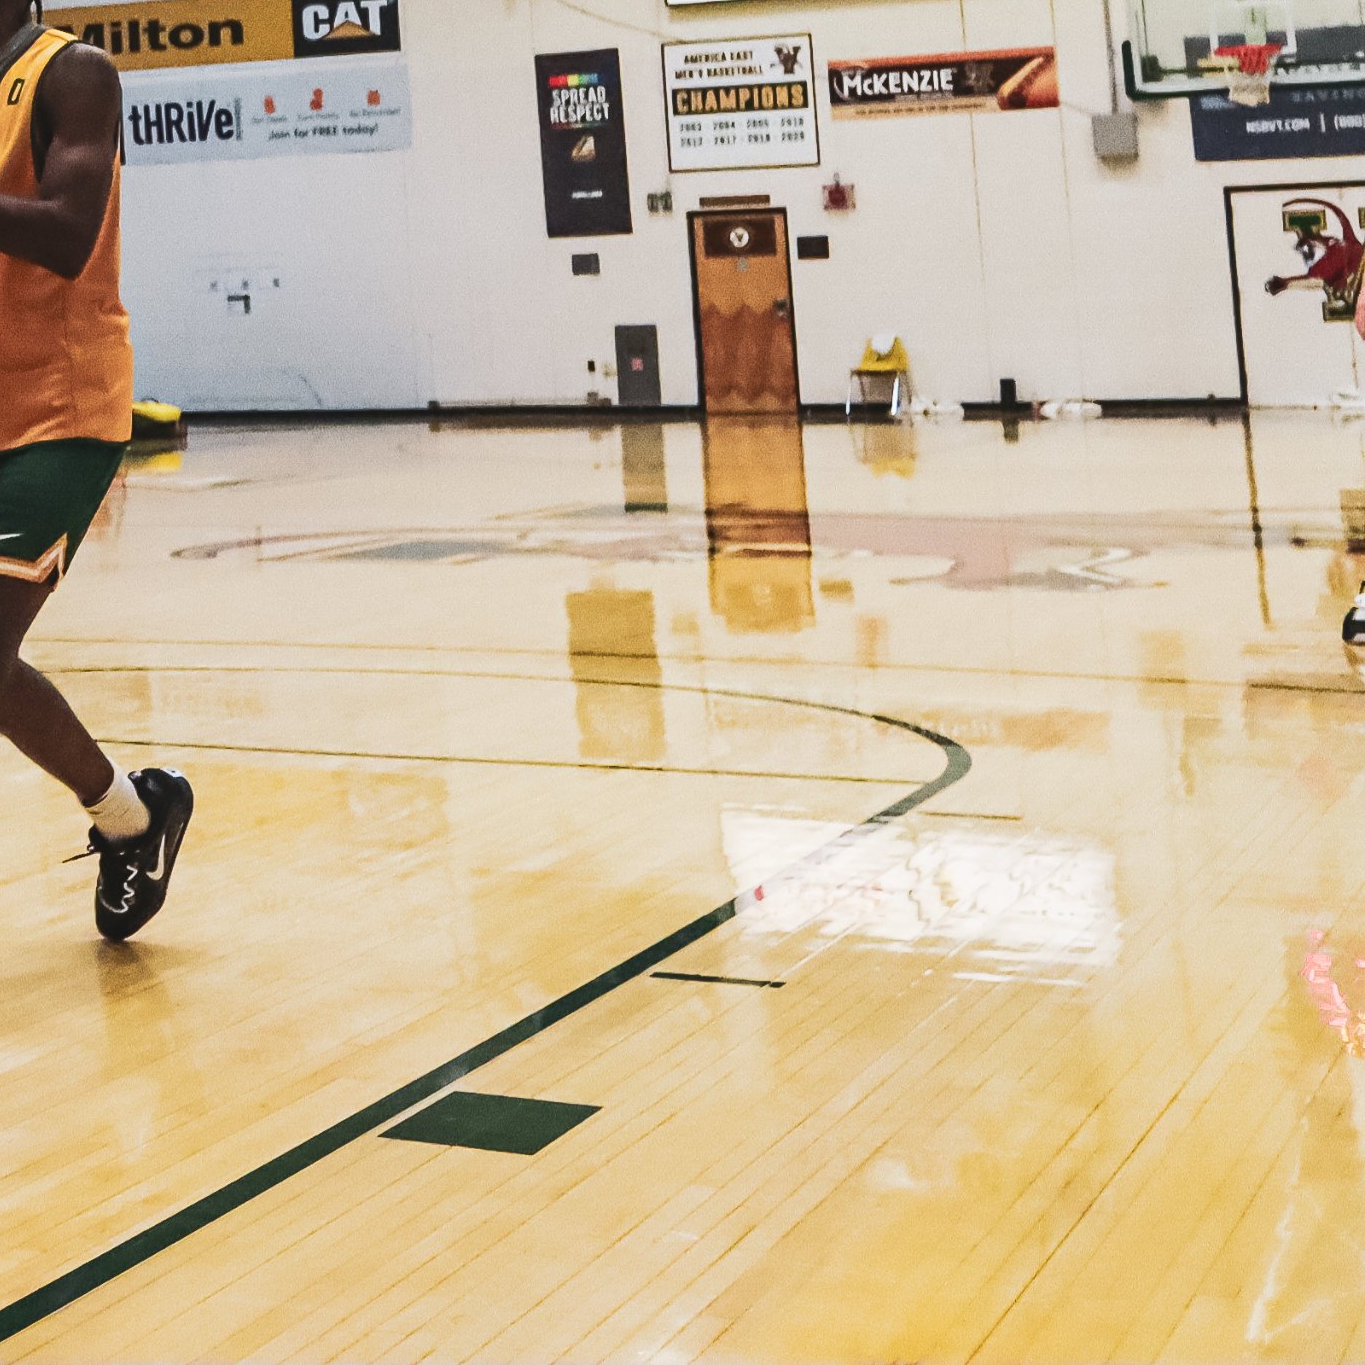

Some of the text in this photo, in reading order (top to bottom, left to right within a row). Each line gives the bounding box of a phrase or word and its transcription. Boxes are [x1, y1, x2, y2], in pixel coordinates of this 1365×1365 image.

[7, 78, 25, 105] 0
[552, 86, 606, 106] SPREAD
[676, 85, 805, 114] CHAMPIONS
[550, 103, 609, 124] RESPECT
